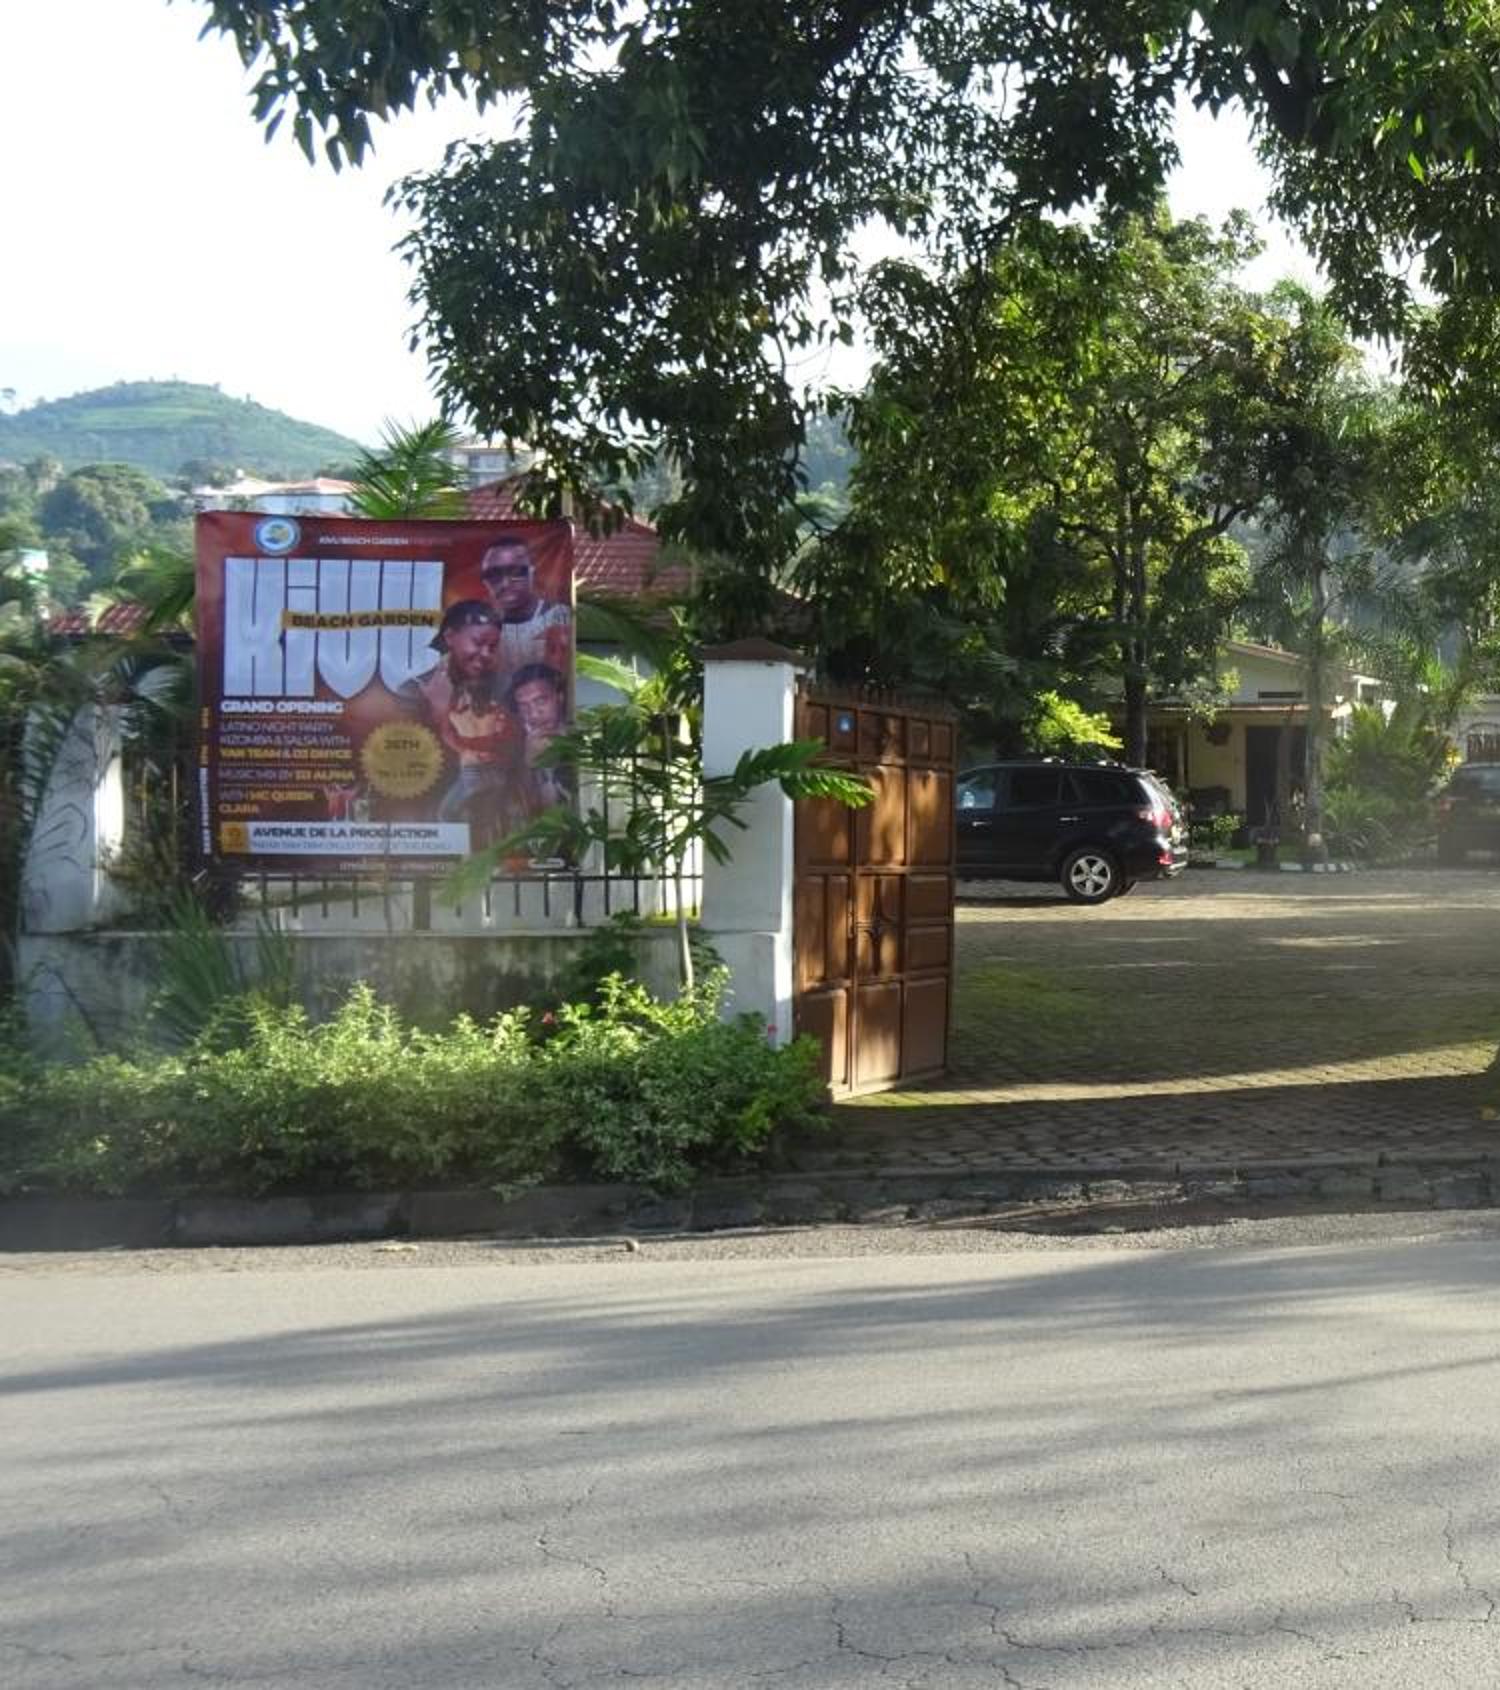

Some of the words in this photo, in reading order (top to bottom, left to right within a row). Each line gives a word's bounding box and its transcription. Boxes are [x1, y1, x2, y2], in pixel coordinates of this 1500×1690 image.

[292, 614, 353, 628] BEACH
[358, 613, 434, 627] GARDEN
[221, 701, 273, 712] GRAND
[276, 701, 344, 713] OPENING
[253, 828, 306, 838] AVENUE
[309, 828, 326, 838] DE
[330, 828, 347, 838] LA
[350, 828, 439, 839] PRODUCTION
